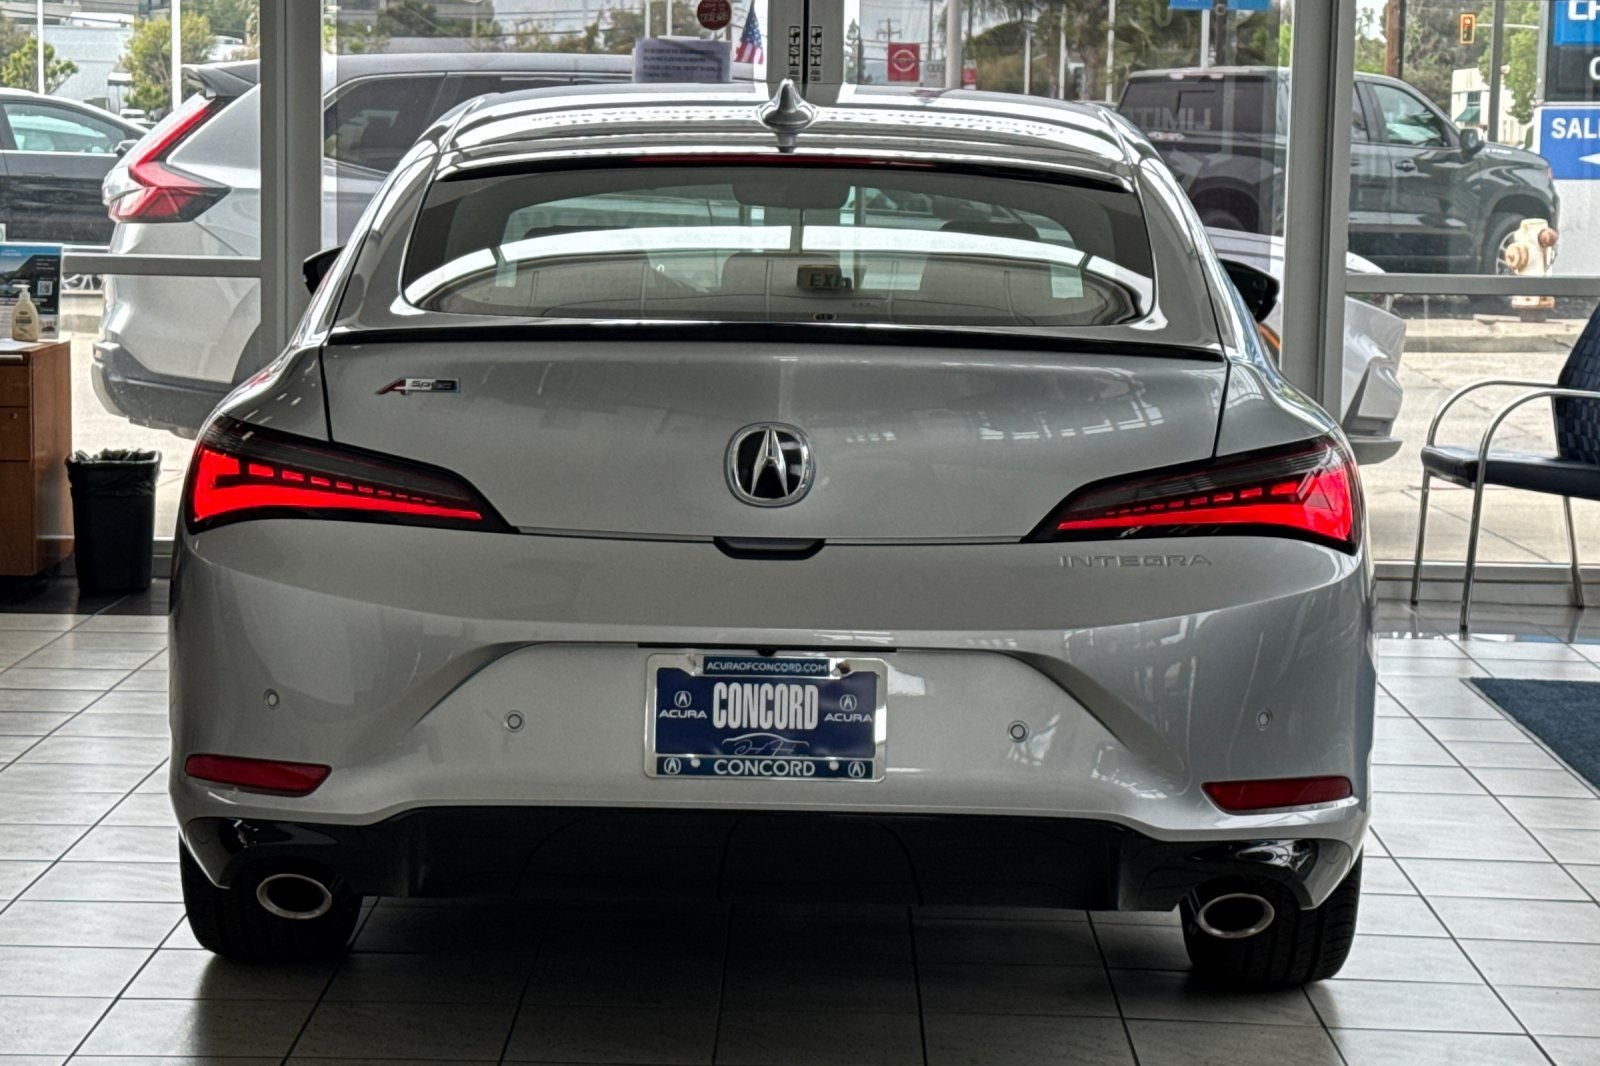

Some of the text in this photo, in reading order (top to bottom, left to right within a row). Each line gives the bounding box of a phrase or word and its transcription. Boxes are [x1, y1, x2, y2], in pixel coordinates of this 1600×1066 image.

[789, 26, 800, 65] PUSH
[811, 26, 822, 65] PUSH
[1551, 117, 1600, 140] SAL
[810, 273, 843, 288] EXI
[1060, 554, 1212, 568] INTEGRA
[706, 660, 828, 674] ACURAOFCONCORD.COM
[658, 708, 708, 719] ACURA
[712, 681, 819, 730] CONCORD
[823, 712, 873, 722] ACURA
[713, 758, 816, 776] CONCORD
